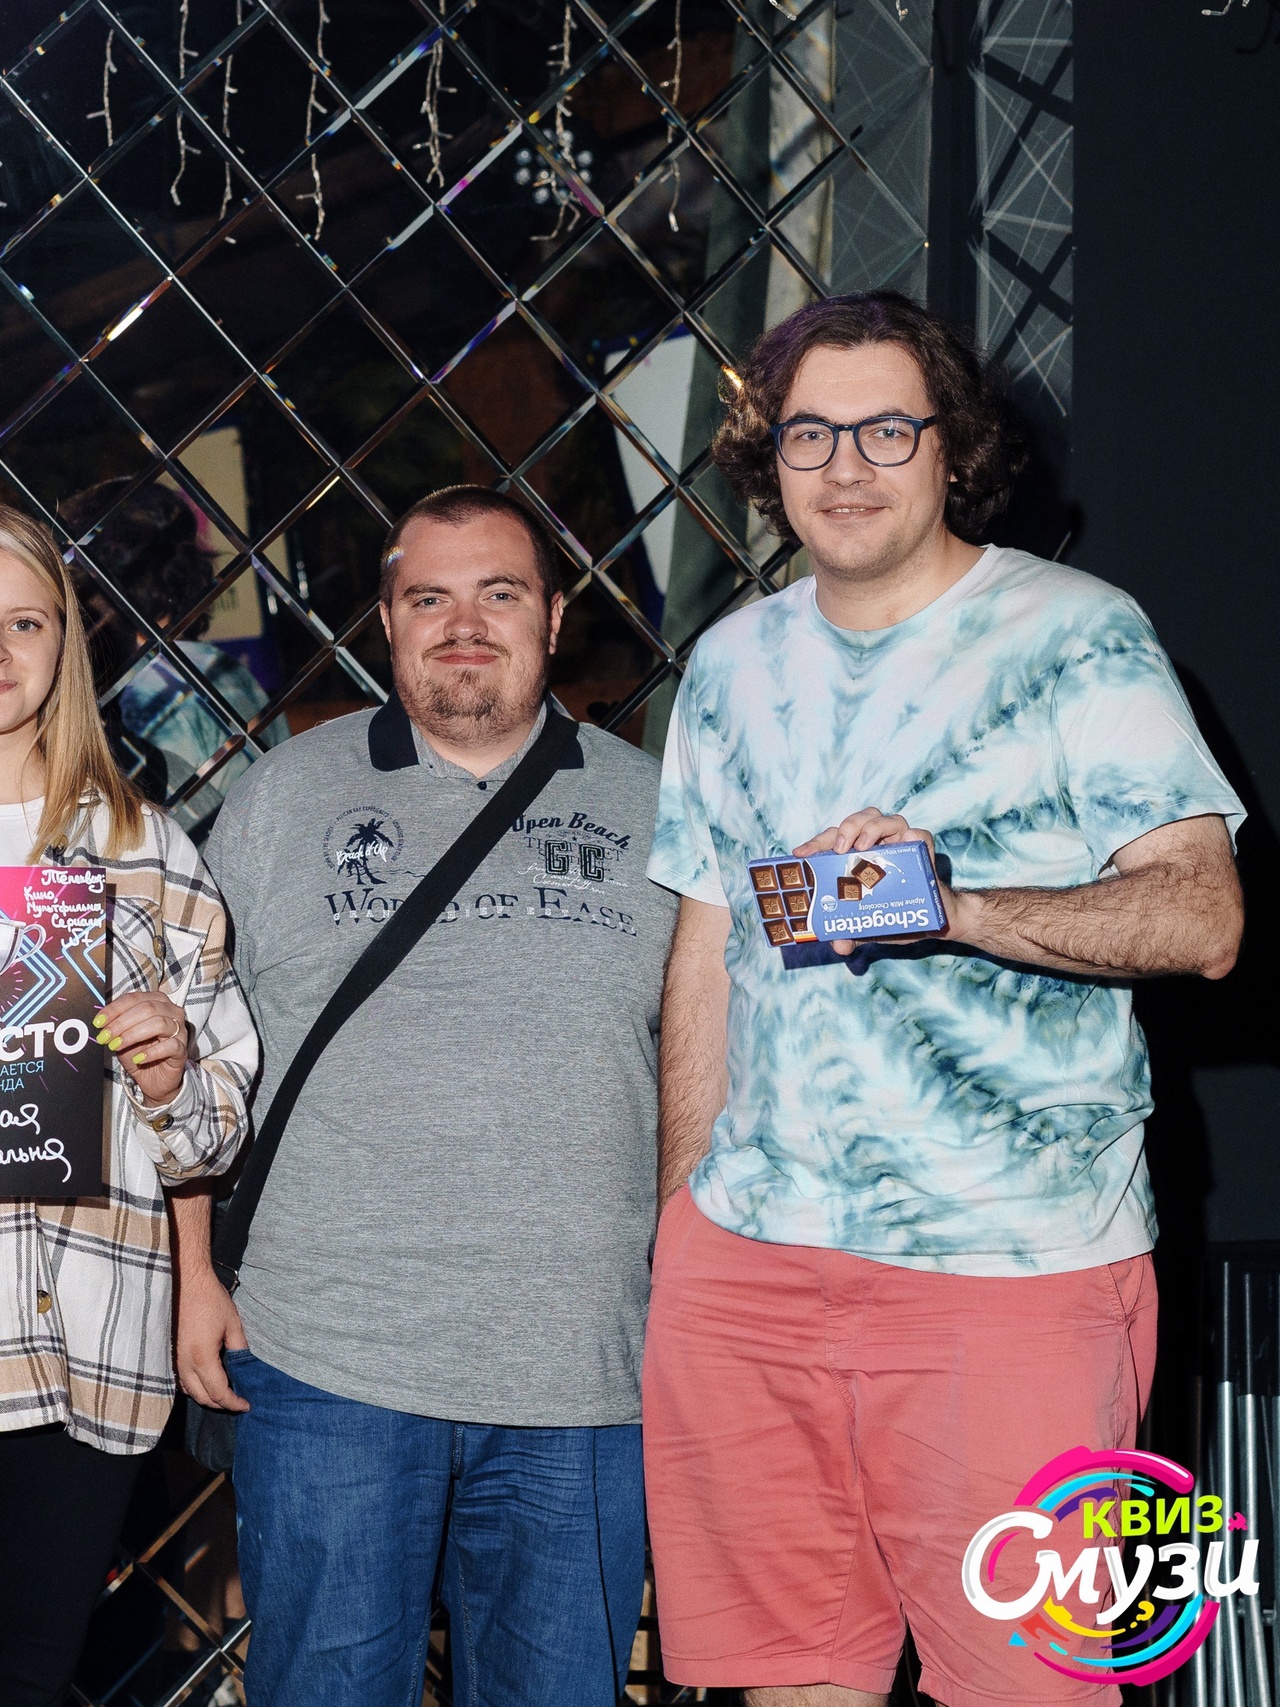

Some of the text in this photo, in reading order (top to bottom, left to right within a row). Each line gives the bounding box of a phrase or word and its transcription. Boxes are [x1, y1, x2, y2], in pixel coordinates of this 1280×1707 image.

[512, 814, 564, 834] Open
[568, 812, 631, 850] Beach
[23, 886, 58, 904] Кино,
[905, 897, 925, 905] Alpine
[475, 894, 518, 919] OF
[859, 903, 889, 911] Chocolate
[824, 909, 929, 935] Schogetten
